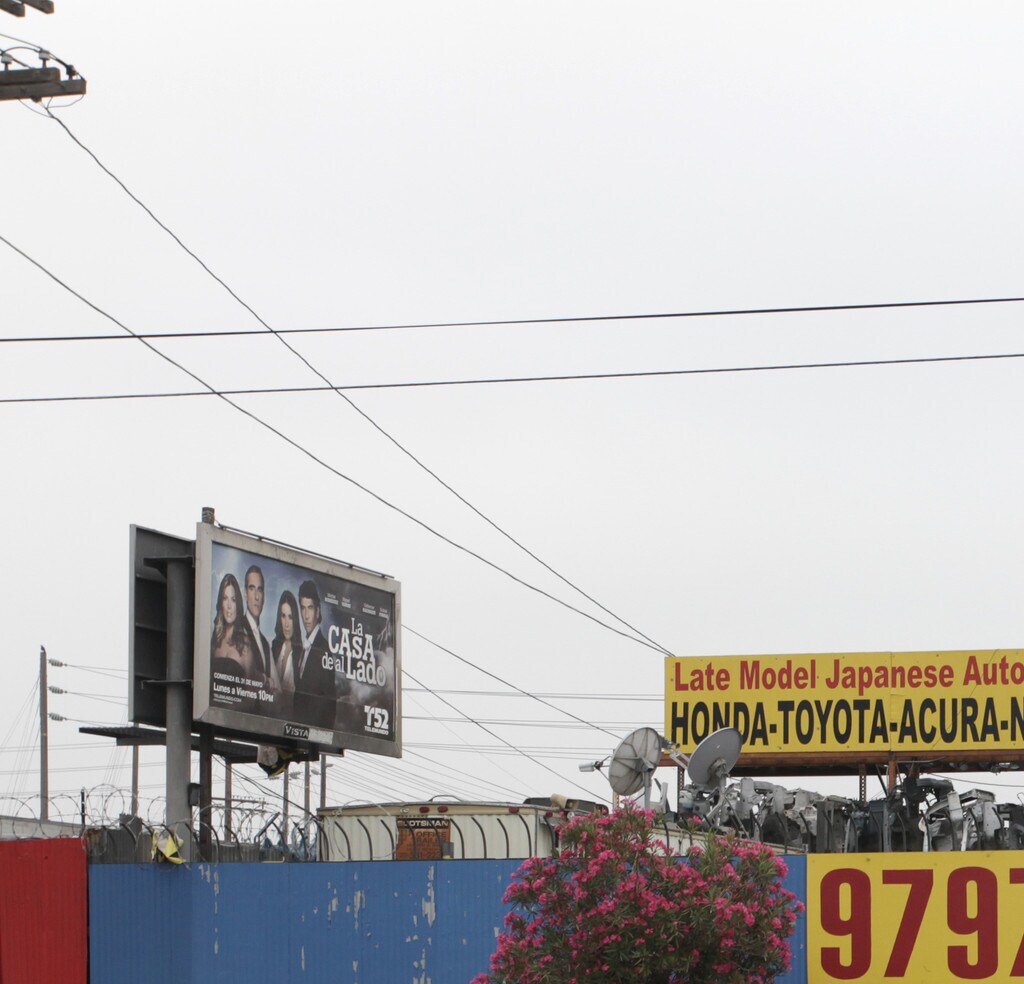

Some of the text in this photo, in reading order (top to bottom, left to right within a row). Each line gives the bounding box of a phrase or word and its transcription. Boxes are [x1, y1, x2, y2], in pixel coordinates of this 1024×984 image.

[328, 625, 375, 661] CASA
[351, 617, 363, 636] La
[322, 652, 386, 687] de al Lado
[675, 662, 730, 691] Late
[740, 659, 816, 690] Model
[825, 659, 954, 696] Japanese
[213, 682, 230, 693] Lunes
[236, 687, 257, 699] Viernes
[258, 690, 274, 702] 10PM
